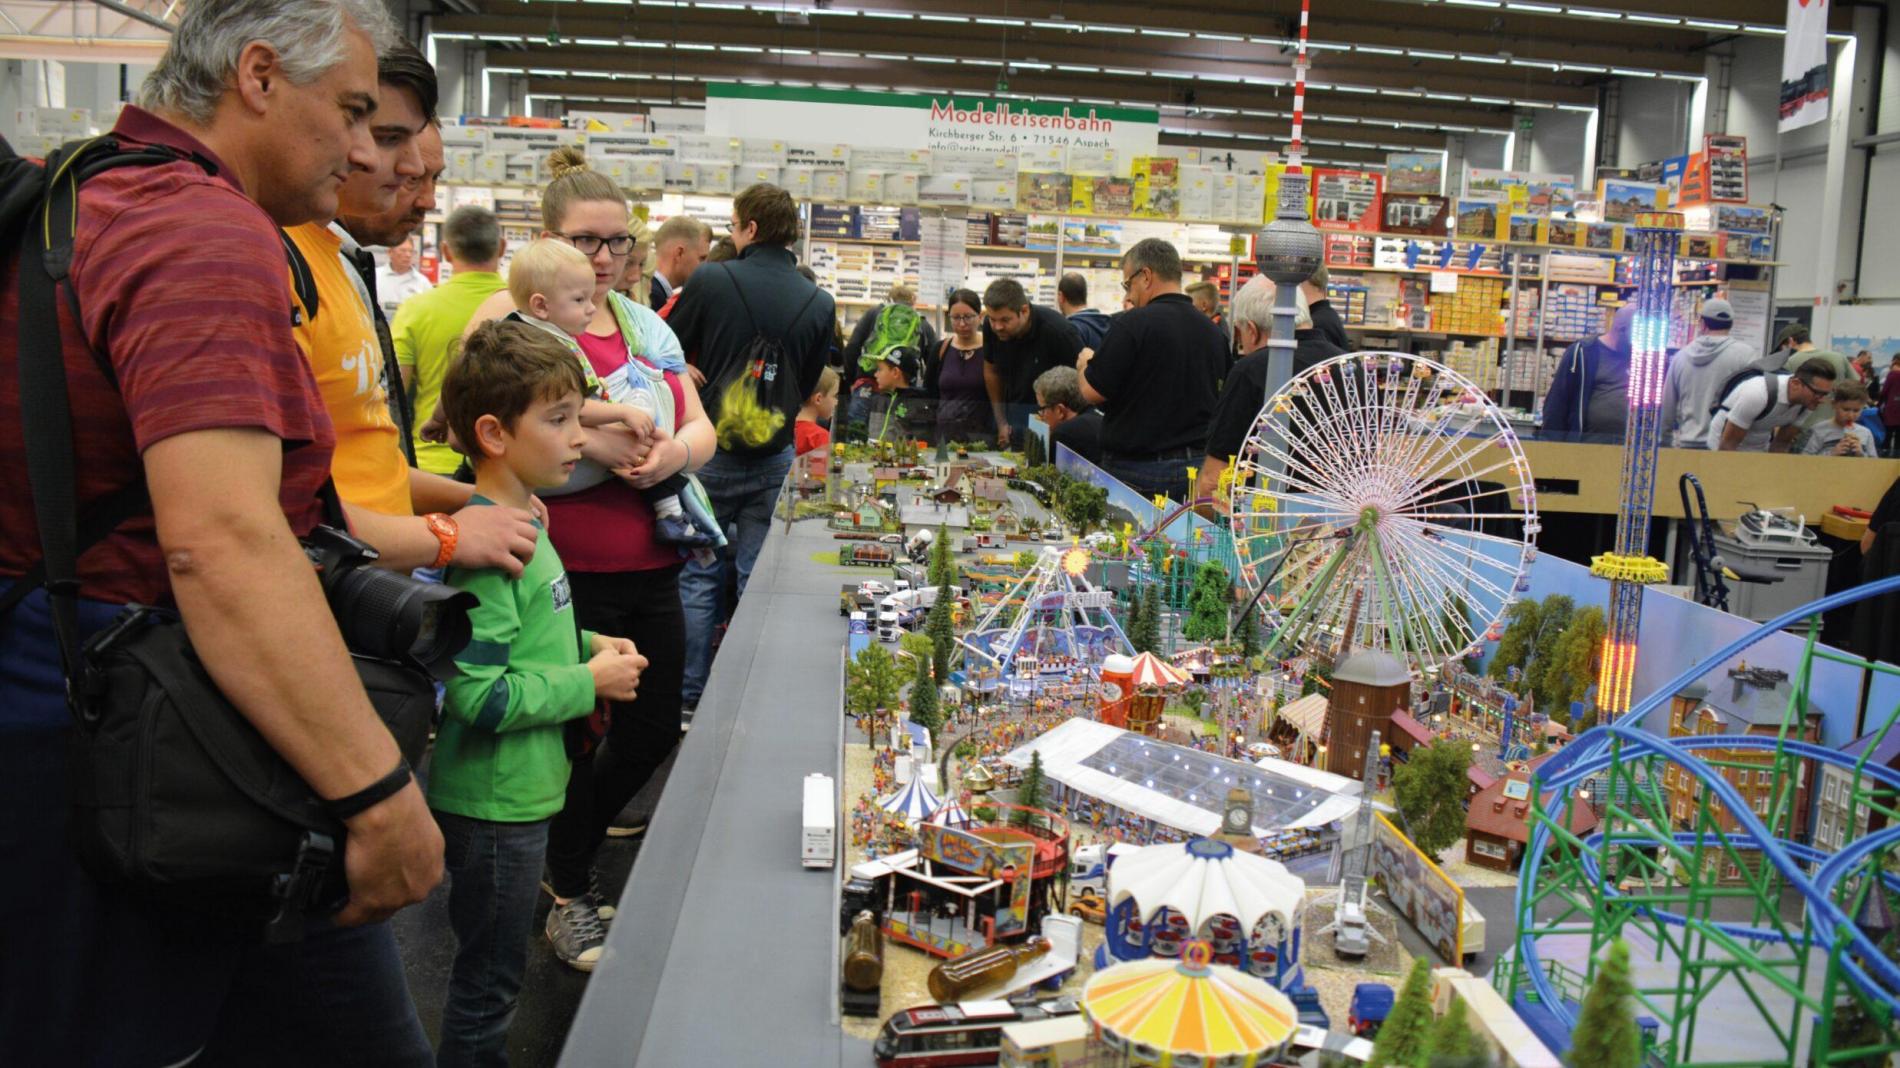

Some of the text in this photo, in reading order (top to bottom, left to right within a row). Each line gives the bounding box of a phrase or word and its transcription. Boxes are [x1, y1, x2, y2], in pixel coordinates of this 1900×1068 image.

[930, 99, 1112, 132] Modelleisenbahn
[928, 128, 984, 142] Kirchberger
[988, 131, 1005, 142] Str.
[1010, 133, 1017, 143] 6
[1034, 134, 1069, 145] 71546
